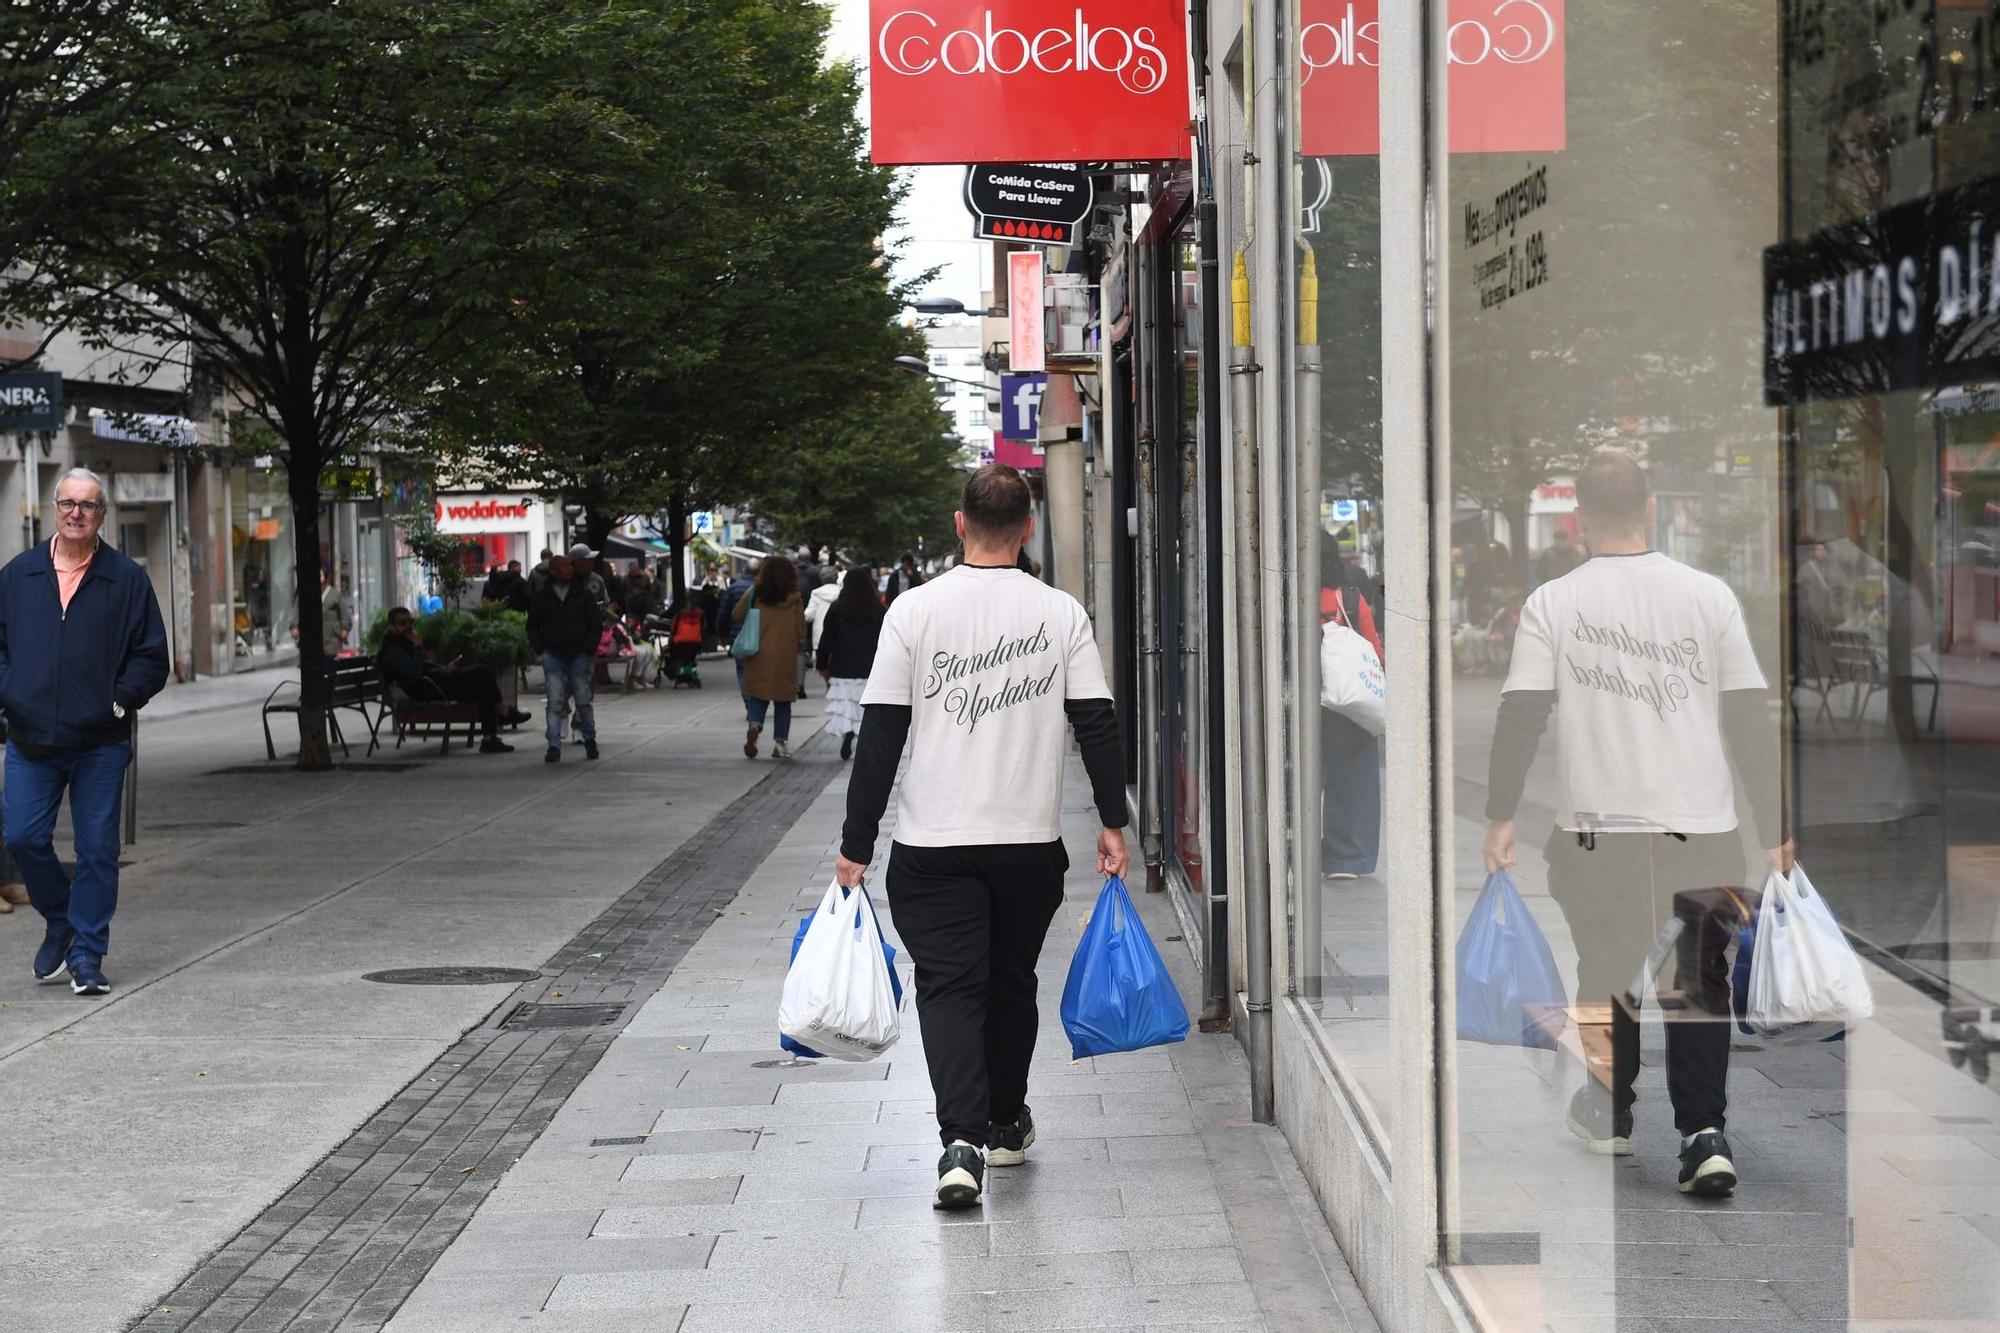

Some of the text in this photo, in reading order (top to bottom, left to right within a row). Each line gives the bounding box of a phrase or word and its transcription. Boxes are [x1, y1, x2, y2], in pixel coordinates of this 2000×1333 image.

[878, 8, 1168, 95] Cabellos
[998, 190, 1063, 206] Para Llevar
[447, 500, 528, 519] vodafone
[923, 621, 1054, 700] Standards
[944, 662, 1059, 735] Updated
